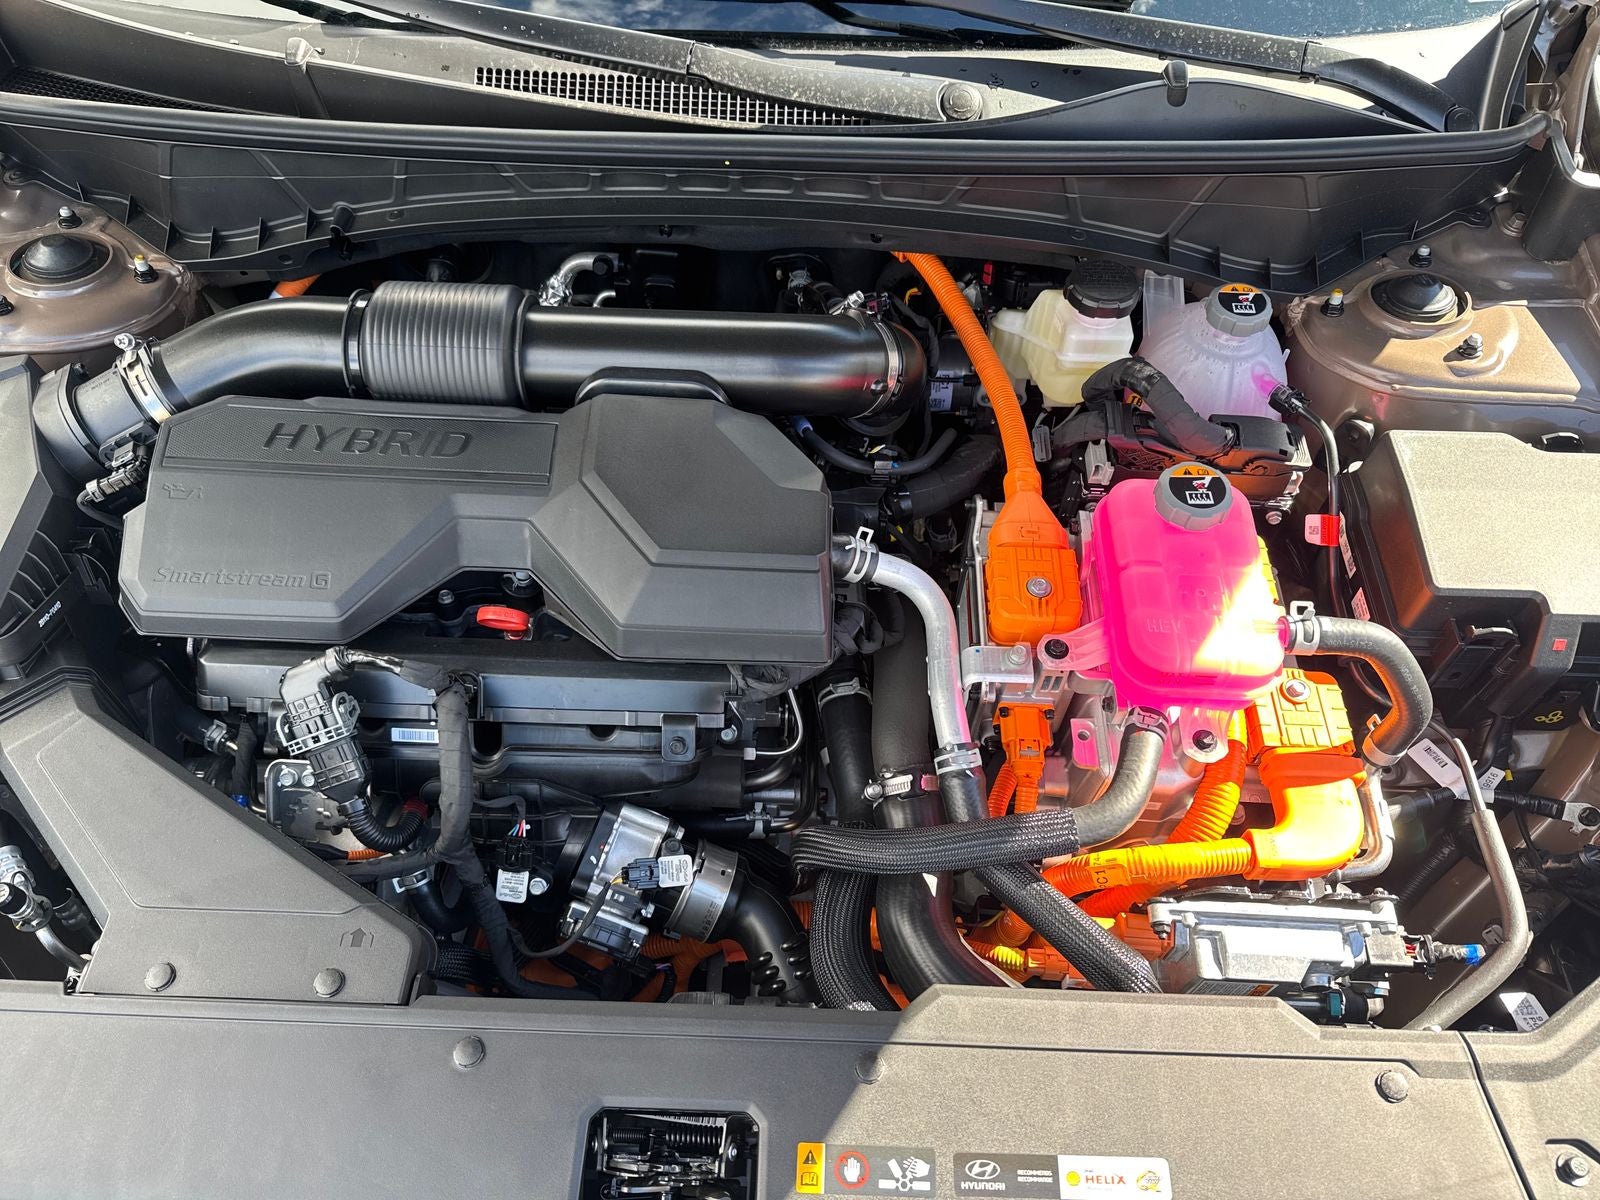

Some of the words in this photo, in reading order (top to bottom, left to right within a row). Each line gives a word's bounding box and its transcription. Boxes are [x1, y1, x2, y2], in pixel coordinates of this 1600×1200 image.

[262, 422, 474, 459] HYBRID
[153, 567, 307, 588] Smartstream
[961, 1181, 1006, 1191] HYUNDAI
[1085, 1174, 1126, 1185] HELIX
